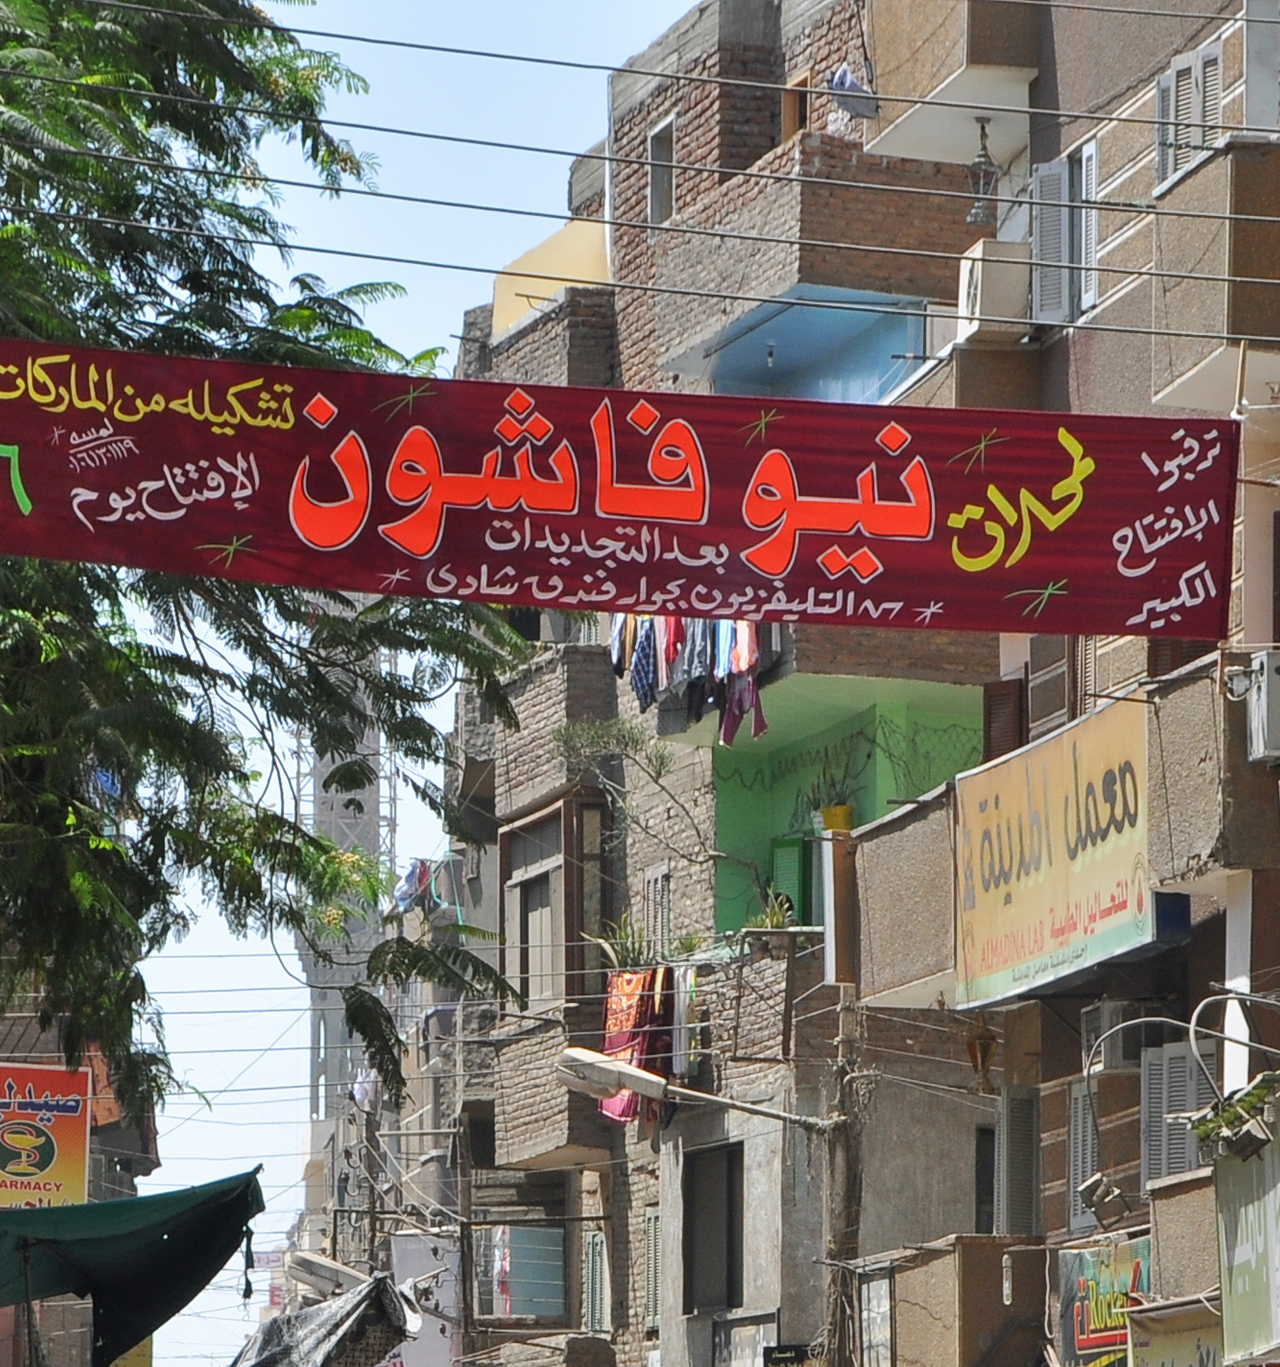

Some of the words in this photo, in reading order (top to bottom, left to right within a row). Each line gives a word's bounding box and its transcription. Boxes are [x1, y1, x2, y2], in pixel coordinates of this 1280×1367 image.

[113, 387, 166, 421] من
[289, 387, 710, 560] فاشون
[1141, 428, 1222, 492] ترقبوا
[69, 483, 139, 533] يوم
[740, 421, 935, 584] نيو
[485, 520, 660, 569] التجديدات
[661, 536, 730, 576] بعد
[525, 571, 617, 606] فندق
[616, 577, 687, 613] بجوار
[690, 579, 855, 621] التليفزيون
[1125, 561, 1218, 627] الكبير
[1064, 740, 1139, 862] معمل
